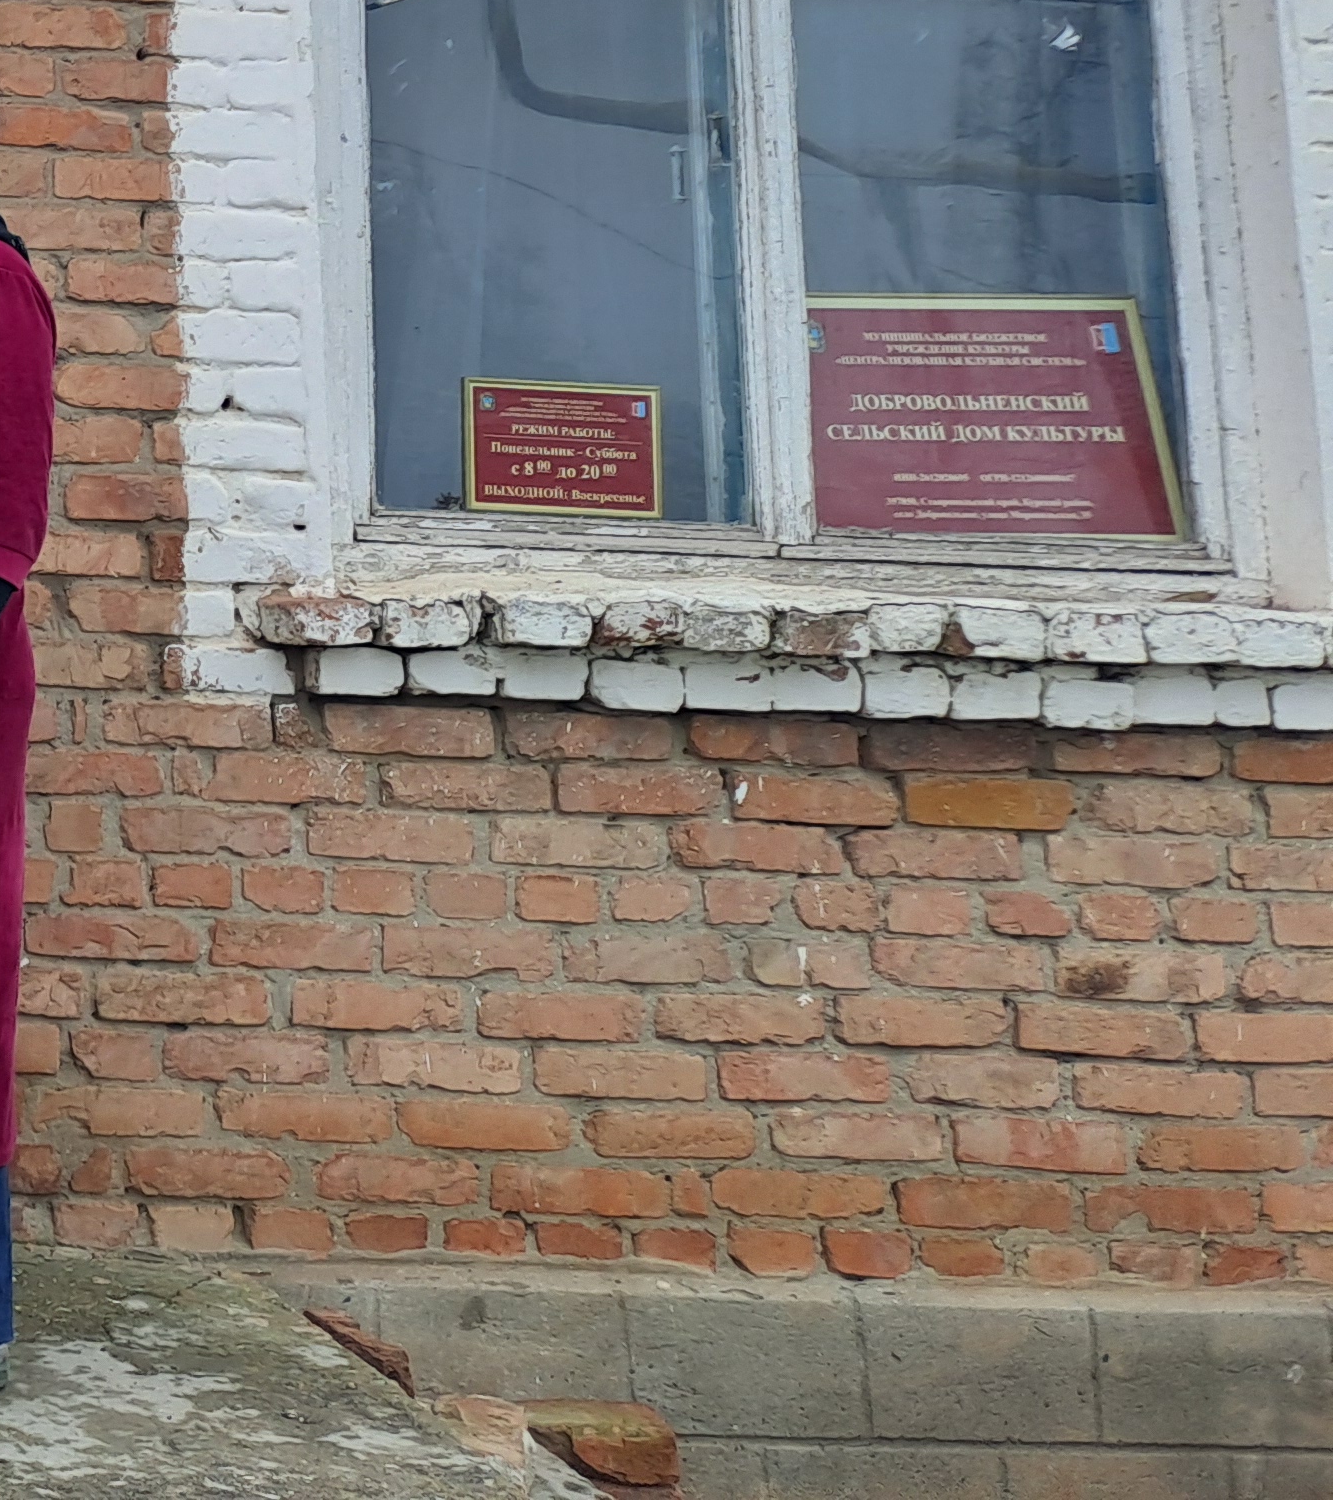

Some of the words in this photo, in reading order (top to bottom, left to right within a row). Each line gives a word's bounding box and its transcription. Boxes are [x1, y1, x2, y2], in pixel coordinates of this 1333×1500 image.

[849, 391, 1090, 413] ДОБРОВОЛЬНЕНСКИЙ
[511, 423, 558, 436] РЕЖИМ
[826, 421, 947, 442] СЕЛЬСКИЙ
[950, 424, 1003, 443] ДОМ
[1005, 425, 1126, 443] КУЛЬТУРЫ
[490, 441, 575, 457] Понедельник
[585, 446, 637, 461] Суббота
[556, 466, 577, 480] до
[571, 489, 647, 504] Воскресенье
